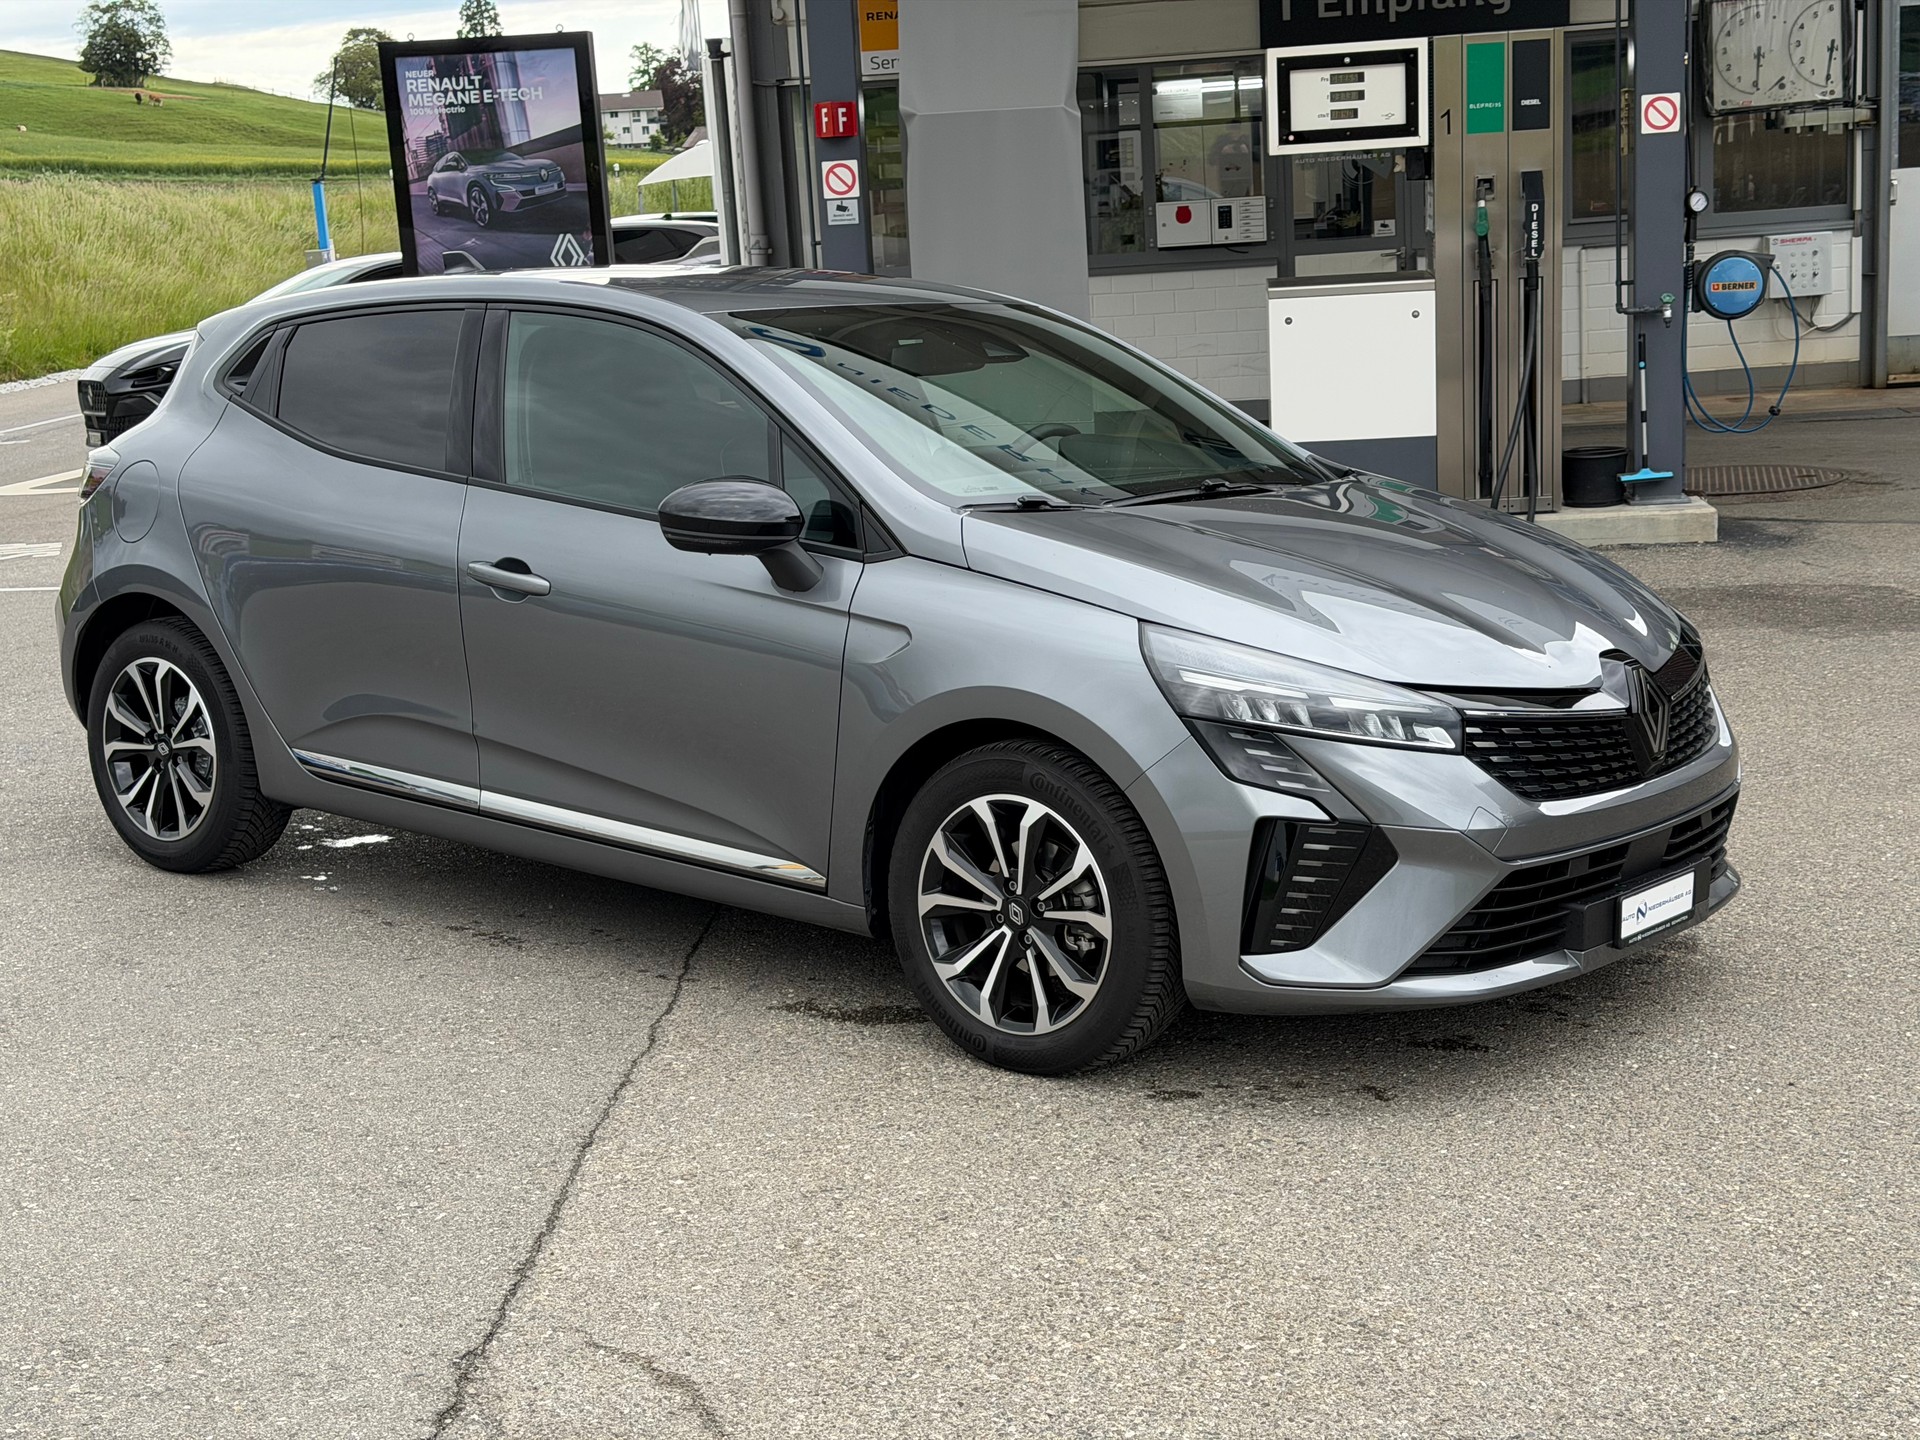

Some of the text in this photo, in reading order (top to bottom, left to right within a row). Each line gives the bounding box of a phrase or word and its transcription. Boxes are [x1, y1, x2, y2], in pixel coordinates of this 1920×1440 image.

[1317, 0, 1511, 23] Empag
[1756, 11, 1760, 19] 6
[1829, 4, 1834, 12] 6
[1722, 47, 1727, 55] 3
[870, 56, 899, 70] Ser
[405, 70, 434, 78] NEUER
[406, 75, 482, 93] RENAULT
[408, 86, 543, 107] MEGANE E-TECH
[410, 106, 466, 116] 100% electric
[821, 107, 829, 133] F
[837, 107, 848, 133] F
[1440, 108, 1451, 135] 1
[1531, 203, 1539, 257] DIESEL
[1780, 236, 1812, 245] SHERPA
[1721, 282, 1755, 290] BERNER
[1030, 772, 1108, 844] Continental
[1622, 913, 1635, 922] AUTO
[918, 982, 987, 1052] Continental
